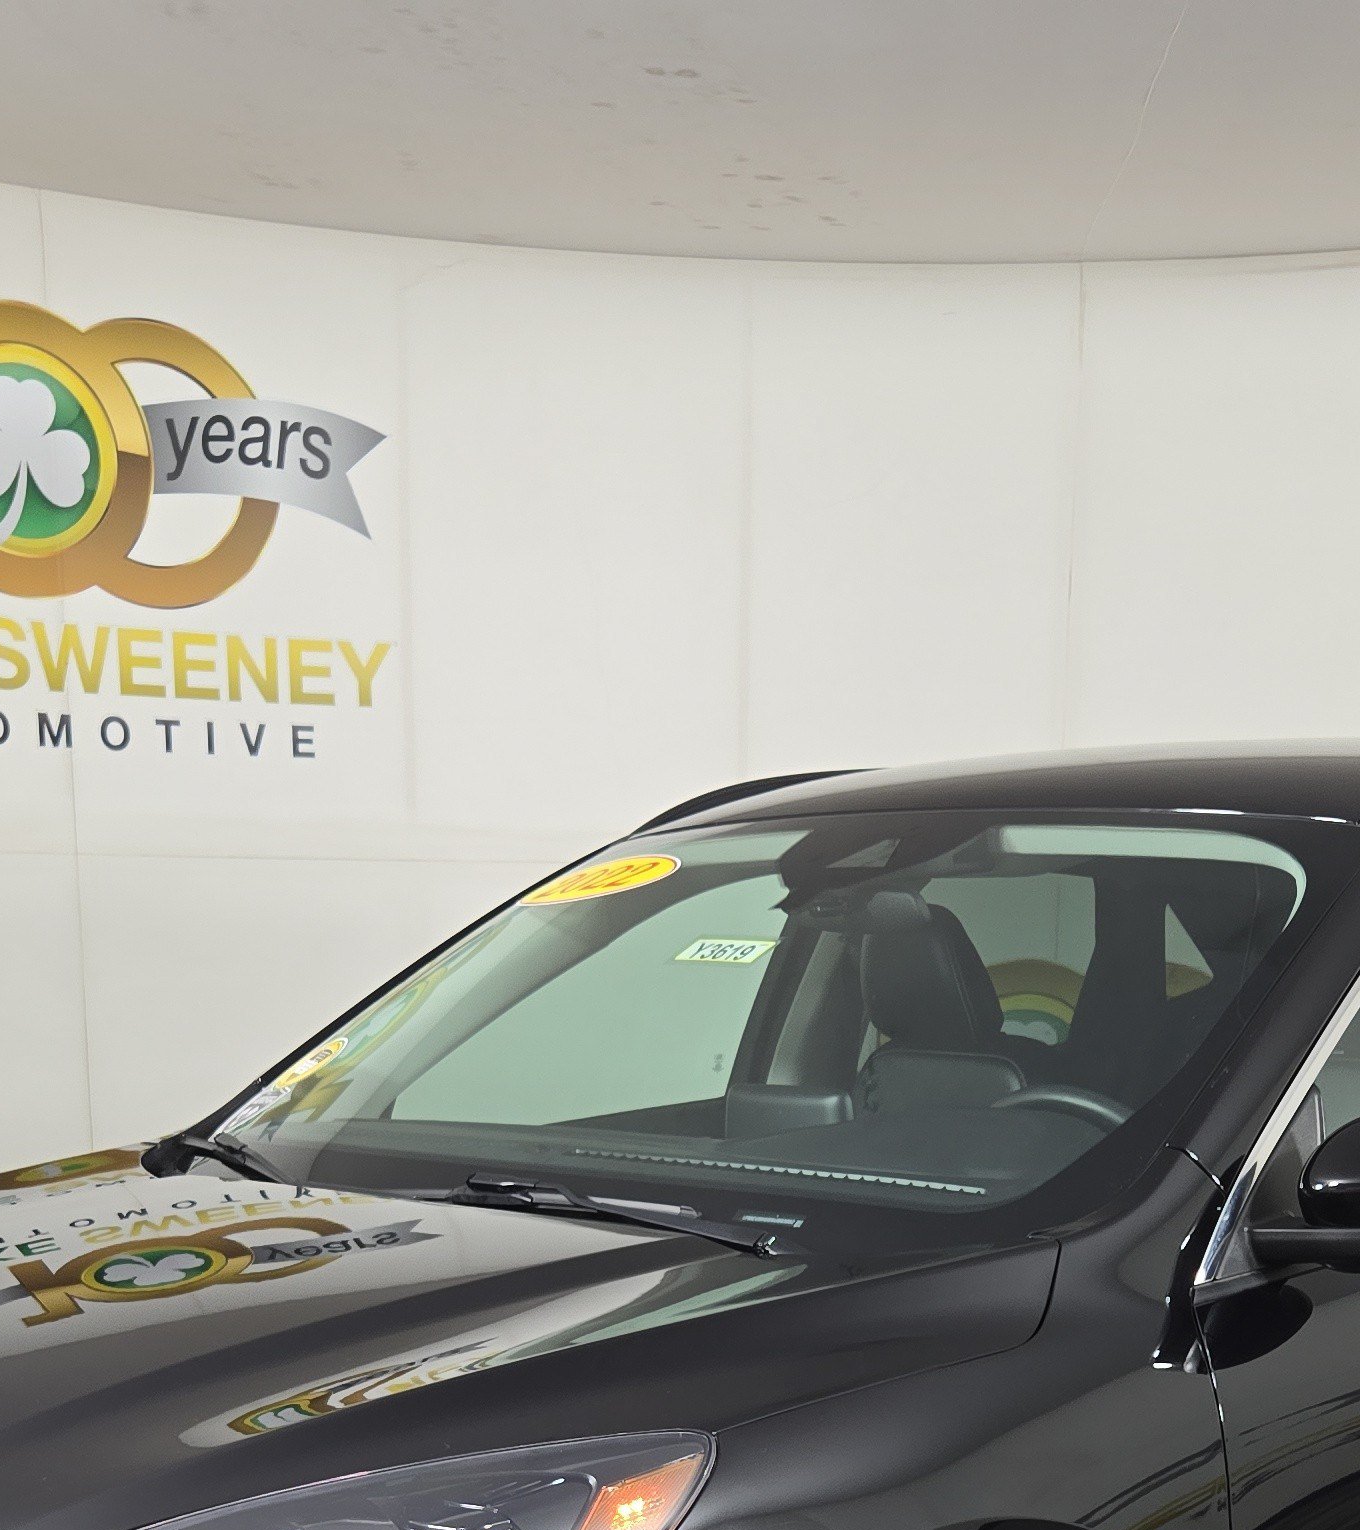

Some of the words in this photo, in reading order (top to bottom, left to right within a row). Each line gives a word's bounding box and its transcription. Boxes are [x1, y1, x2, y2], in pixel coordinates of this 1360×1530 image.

[165, 414, 333, 480] years
[534, 861, 661, 899] 2022
[689, 942, 757, 961] Y3619
